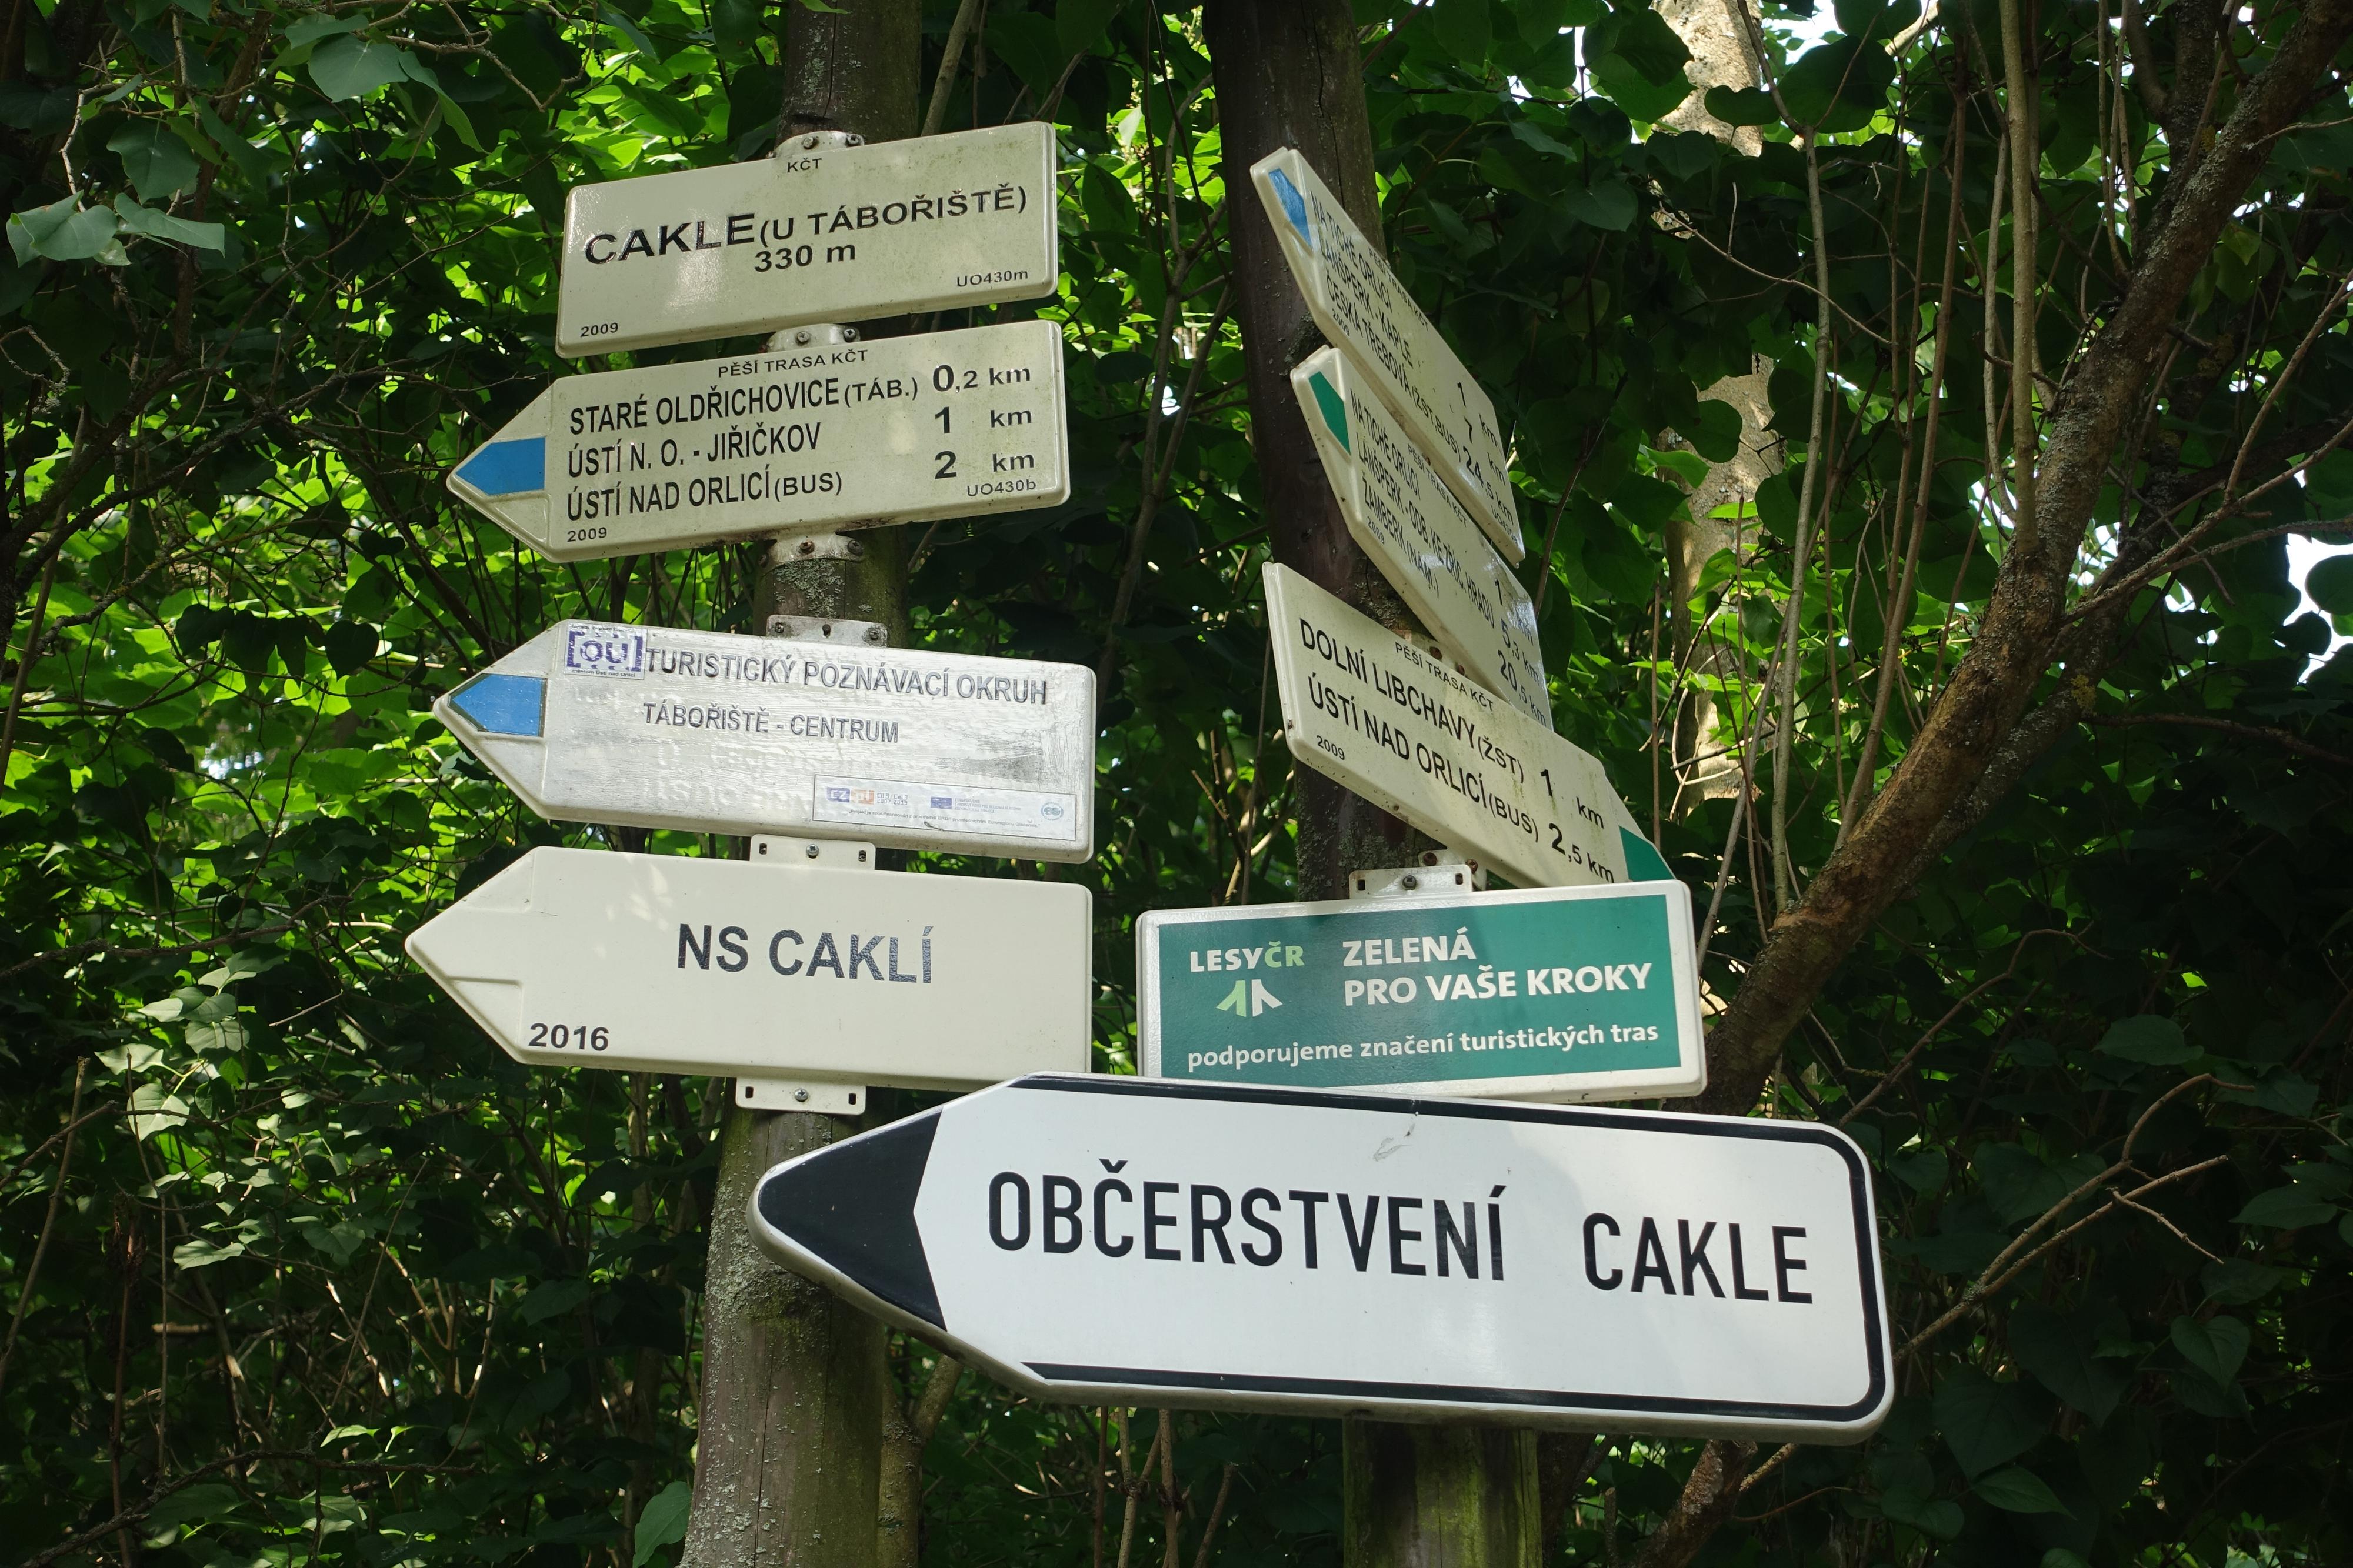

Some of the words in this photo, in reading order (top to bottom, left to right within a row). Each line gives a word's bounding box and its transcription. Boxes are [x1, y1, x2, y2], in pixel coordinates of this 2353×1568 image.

[787, 158, 822, 173] KČT
[809, 183, 1027, 233] TÁBOŘIŠTĚ)
[1310, 190, 1328, 231] NA
[755, 245, 813, 273] 330
[826, 243, 856, 263] m
[956, 270, 1029, 288] UO430m
[1318, 227, 1374, 320] LANŠPERK
[1378, 307, 1414, 369] KAPLE
[1387, 272, 1413, 311] TRASA
[581, 322, 619, 338] 2009
[1326, 268, 1363, 338] ČESKÁ
[1362, 318, 1412, 398] TŘEBOVÁ
[1332, 308, 1350, 336] 2009
[718, 360, 759, 378] PĚŠÍ
[765, 355, 826, 374] TRASA
[831, 348, 868, 368] KČT
[932, 363, 978, 393] 0,2
[988, 365, 1031, 386] km
[570, 394, 648, 436] STARÉ
[935, 406, 952, 435] 1
[990, 406, 1032, 429] km
[1350, 388, 1365, 429] NA
[1457, 382, 1466, 407] 1
[1479, 413, 1503, 457] km
[568, 438, 622, 479] ÚSTÍ
[629, 441, 654, 471] N.
[661, 438, 685, 466] O.
[707, 422, 822, 463] JIŘIČKOV
[934, 451, 958, 480] 2
[992, 452, 1035, 473] km
[1464, 416, 1472, 443] 7
[1487, 452, 1505, 485] km
[568, 483, 621, 521] ÚSTÍ
[629, 482, 680, 513] NAD
[966, 478, 1036, 498] UO430b
[1427, 469, 1452, 508] TRASA
[1496, 491, 1514, 525] km
[1357, 432, 1405, 515] LANŠPERK
[1465, 571, 1495, 629] HRADU
[1362, 470, 1407, 554] ŽAMBERK
[1367, 516, 1385, 545] 2009
[567, 527, 608, 543] 2009
[1495, 579, 1503, 606] 1
[1300, 618, 1367, 685] DOLNÍ
[1501, 618, 1520, 661] 5,3
[646, 646, 796, 687] TURISTICKÝ
[803, 656, 949, 699] POZNÁVACÍ
[957, 673, 1047, 705] OKRUH
[1395, 642, 1424, 667] PĚŠÍ
[1428, 660, 1467, 696] TRASA
[1469, 684, 1494, 712] KČT
[1498, 649, 1528, 704] 20,5
[1529, 695, 1546, 727] km
[643, 700, 769, 734] TÁBOŘIŠTĚ
[791, 713, 899, 744] CENTRUM
[1308, 671, 1359, 732] ÚSTÍ
[1365, 713, 1409, 762] NAD
[1316, 735, 1346, 761] 2009
[1540, 769, 1553, 797] 1
[1576, 796, 1604, 829] km
[1549, 823, 1582, 865] 2,5
[1587, 852, 1614, 884] km
[678, 923, 749, 973] NS
[769, 926, 934, 985] CAKLÍ
[1344, 926, 1476, 968] ZELENÁ
[1344, 978, 1417, 1006] PRO
[1425, 965, 1515, 1002] VAŠE
[1528, 963, 1652, 997] KROKY
[529, 1023, 609, 1052] 2016
[1188, 1041, 1353, 1073] podporujeme
[1360, 1032, 1454, 1057] značení
[1459, 1023, 1604, 1053] turistických
[1611, 1022, 1658, 1042] tras
[988, 1157, 1504, 1282] OBČERSTVENÍ
[1582, 1213, 1813, 1305] CAKLE
